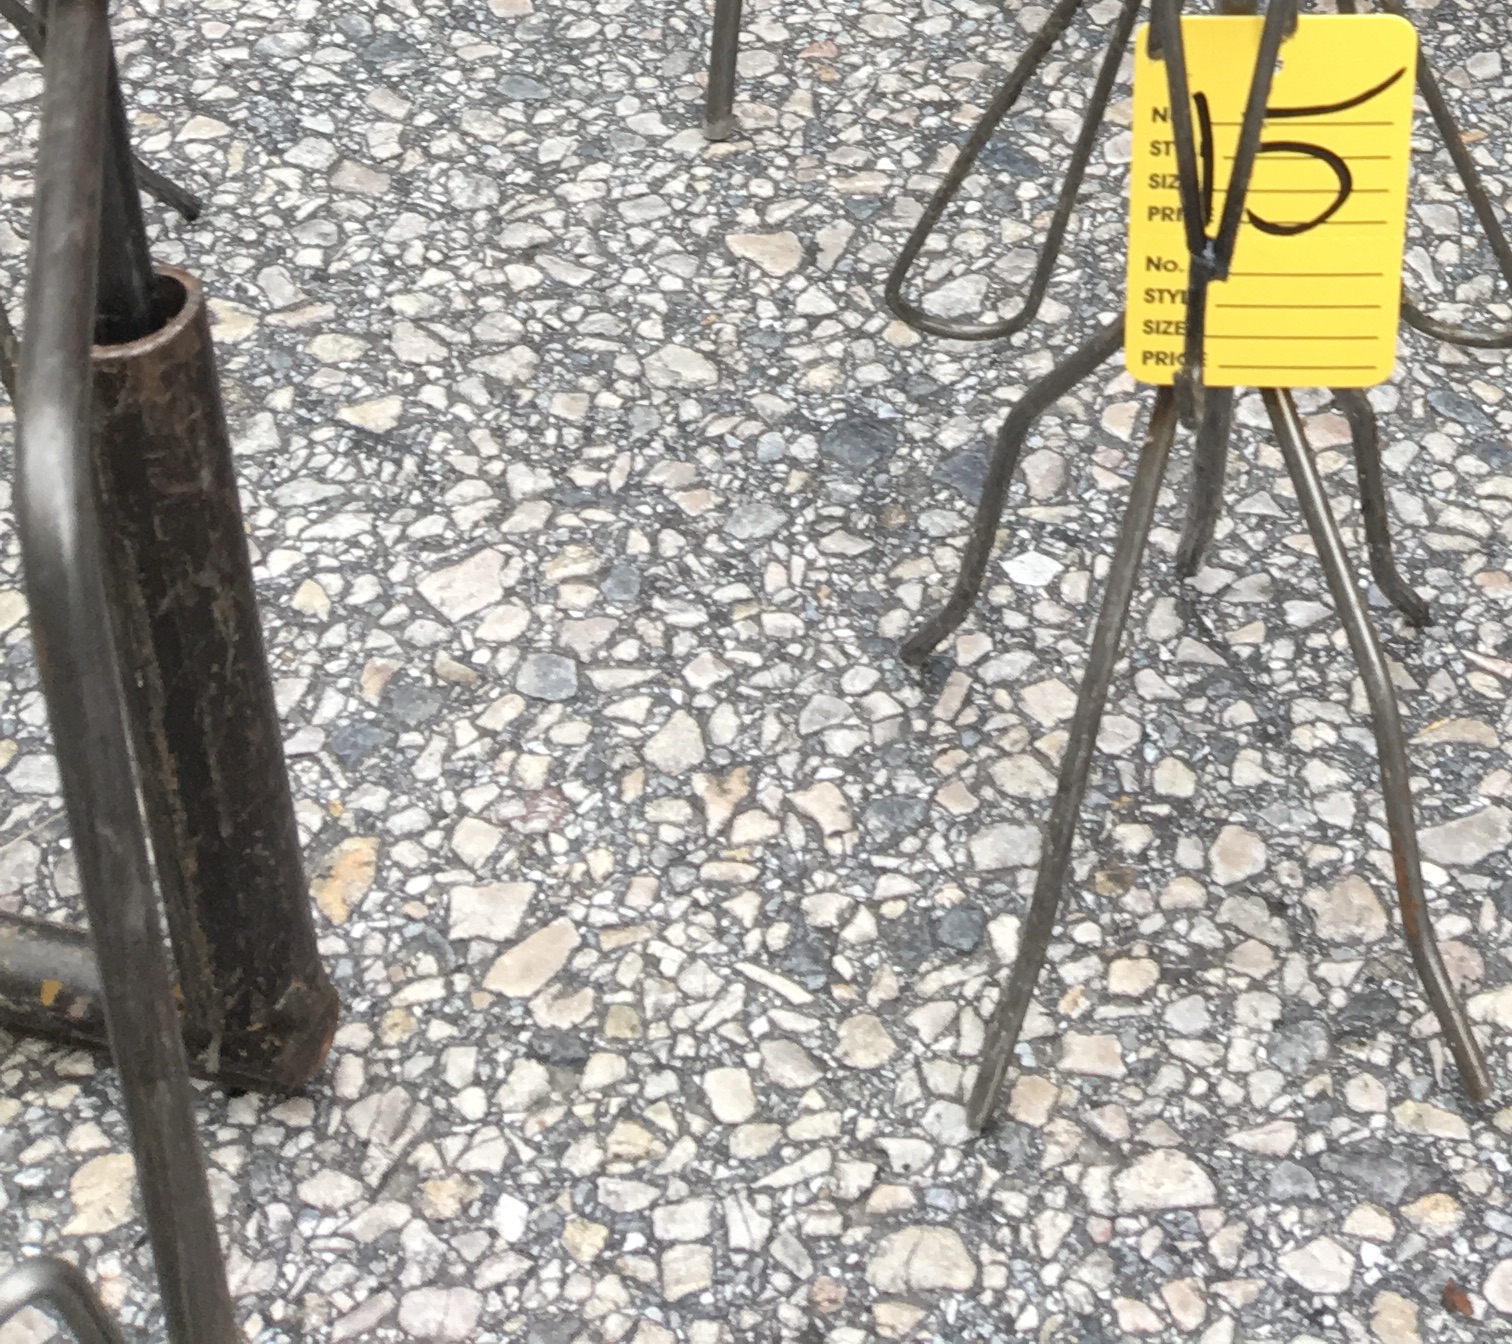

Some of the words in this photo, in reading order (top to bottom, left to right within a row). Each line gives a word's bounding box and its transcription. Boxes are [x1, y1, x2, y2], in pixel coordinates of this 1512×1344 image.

[1193, 67, 1407, 236] 15
[1148, 173, 1180, 189] SIZ
[1145, 256, 1184, 272] No.
[1144, 288, 1188, 304] STYL
[1142, 319, 1187, 335] SIZE
